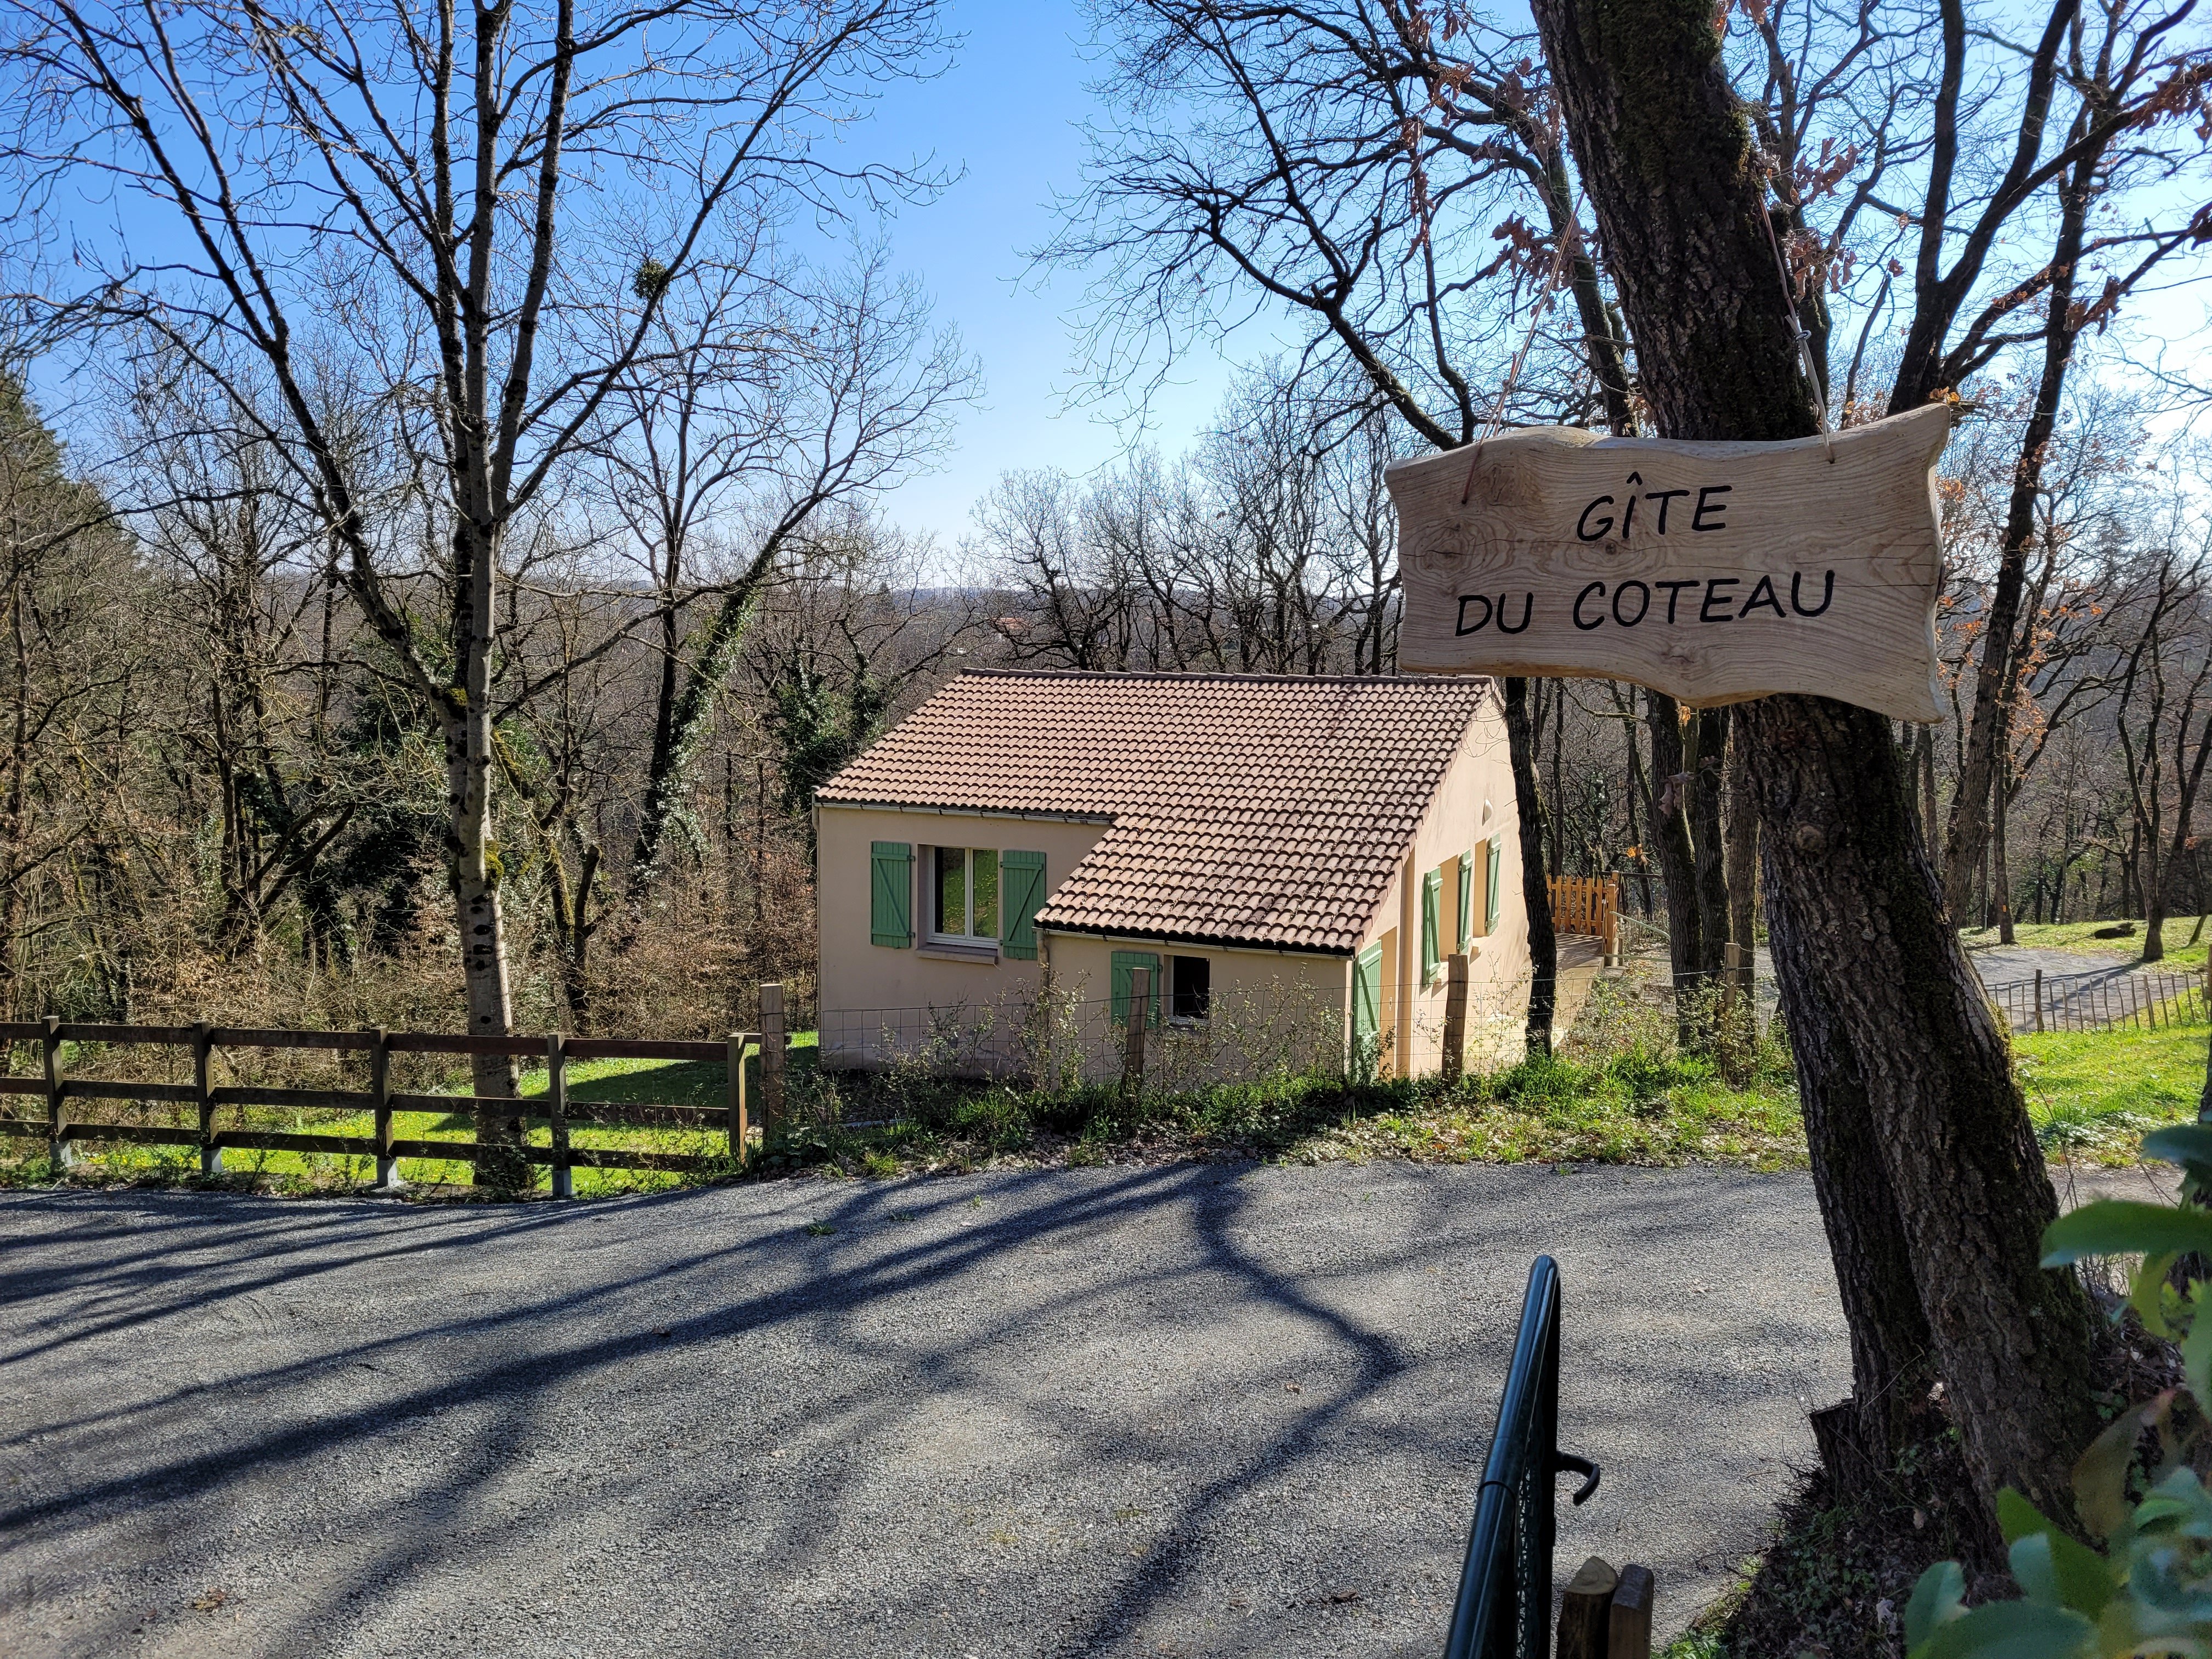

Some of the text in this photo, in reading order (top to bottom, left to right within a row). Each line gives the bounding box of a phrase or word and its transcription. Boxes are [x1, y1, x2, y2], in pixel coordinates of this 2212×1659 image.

[1576, 471, 1733, 542] GÎTE
[1454, 569, 1836, 637] DU COTEAU
